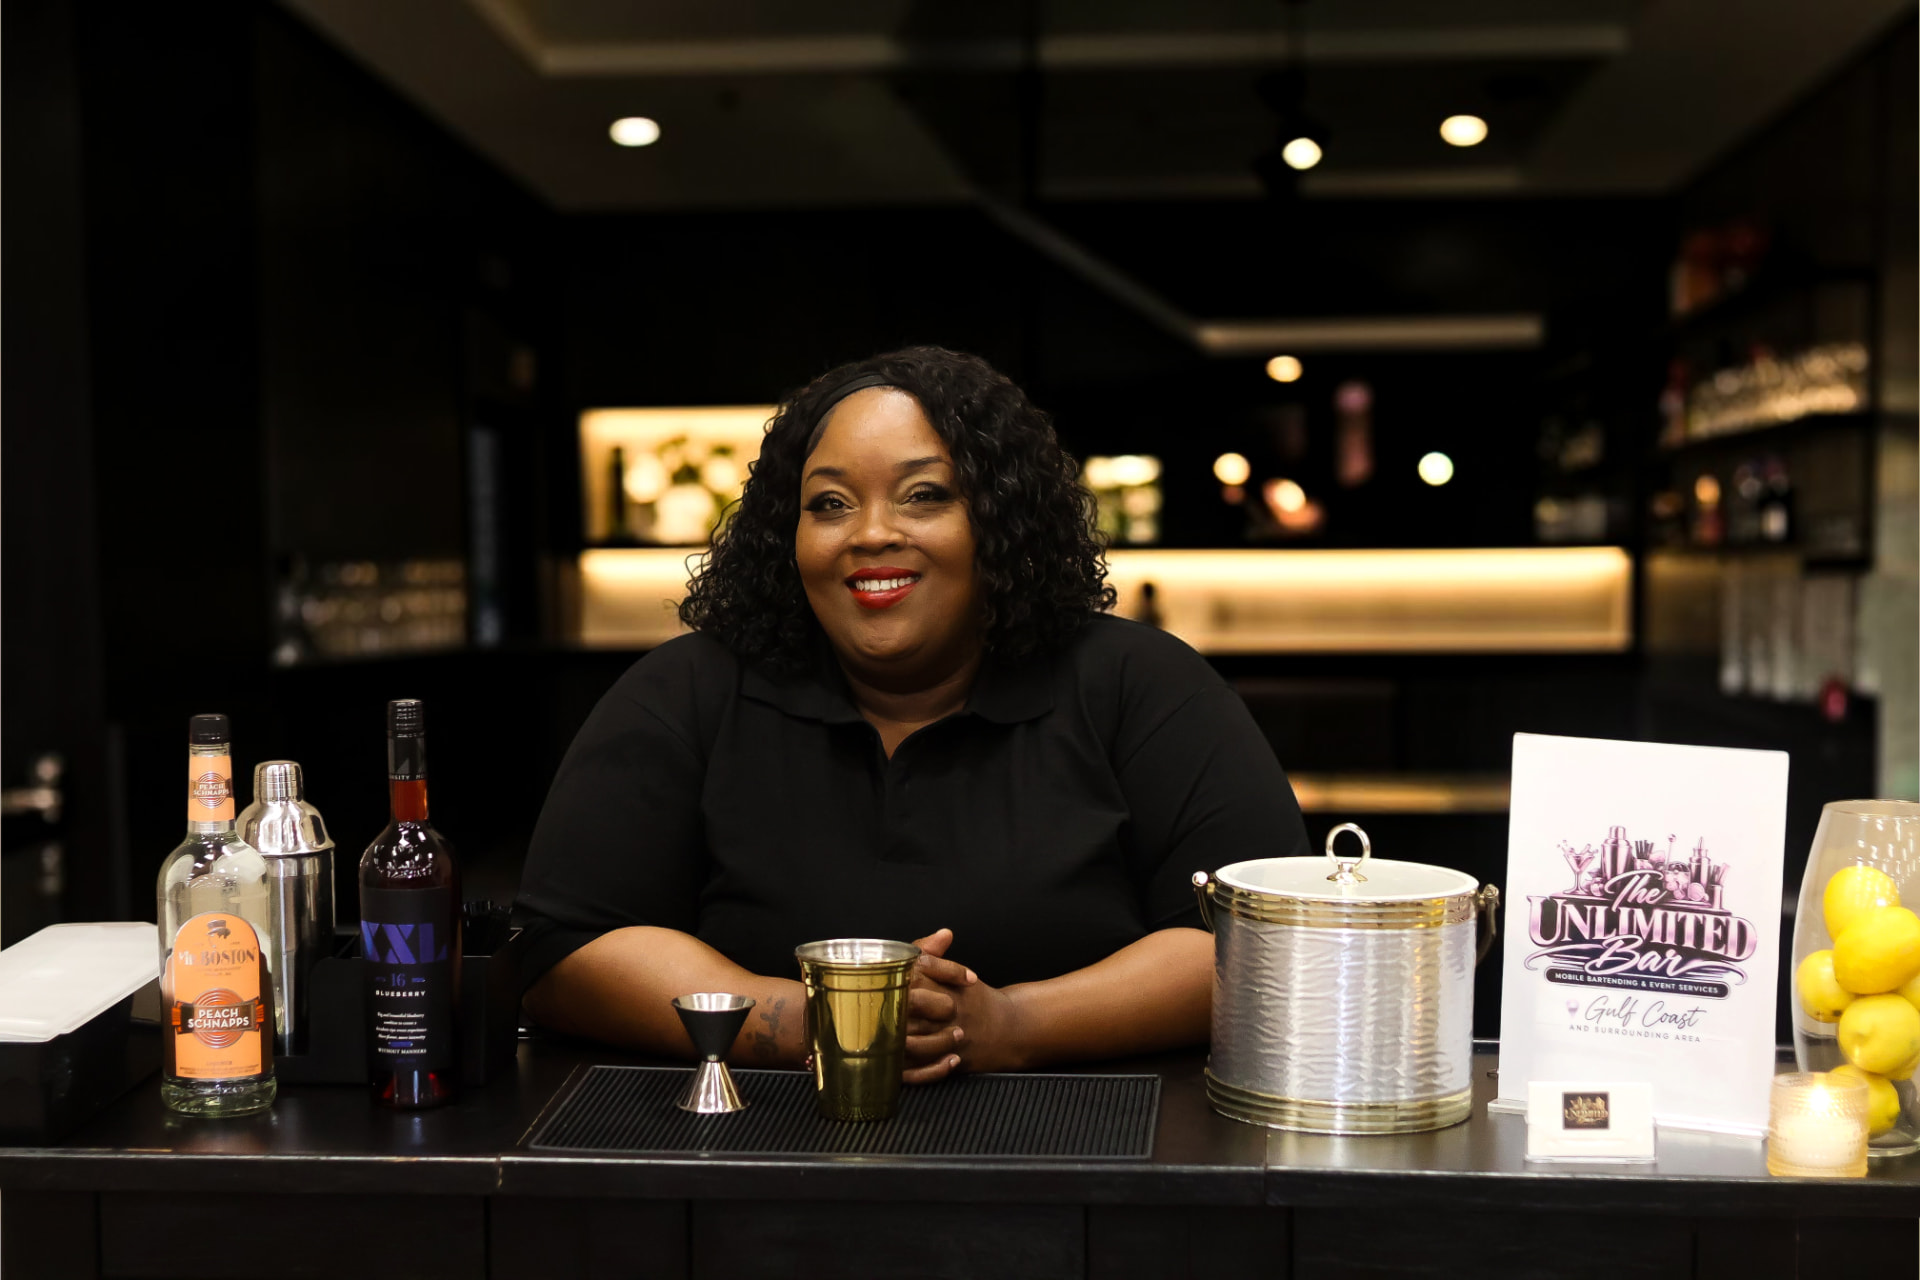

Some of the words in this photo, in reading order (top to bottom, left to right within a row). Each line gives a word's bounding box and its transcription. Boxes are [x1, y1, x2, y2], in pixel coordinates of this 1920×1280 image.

[193, 788, 230, 796] SCHNAPPS
[1604, 868, 1668, 913] The
[1526, 895, 1758, 962] UNLIMITED
[361, 920, 448, 965] XXL
[201, 948, 256, 967] BOSTON
[1584, 933, 1698, 978] Bar
[391, 973, 406, 988] 16
[1554, 972, 1585, 982] MOBILE
[1586, 976, 1639, 987] BARTENDING
[1649, 981, 1676, 990] EVENT
[1678, 983, 1719, 994] SERVICES
[187, 1016, 250, 1029] SCHNAPPS
[198, 1008, 239, 1019] PEACH
[1584, 995, 1639, 1027] Gulf
[1641, 1000, 1708, 1030] Coast
[1568, 1024, 1591, 1032] AND
[1593, 1026, 1670, 1040] SURROUNDING
[1674, 1034, 1702, 1043] AREA
